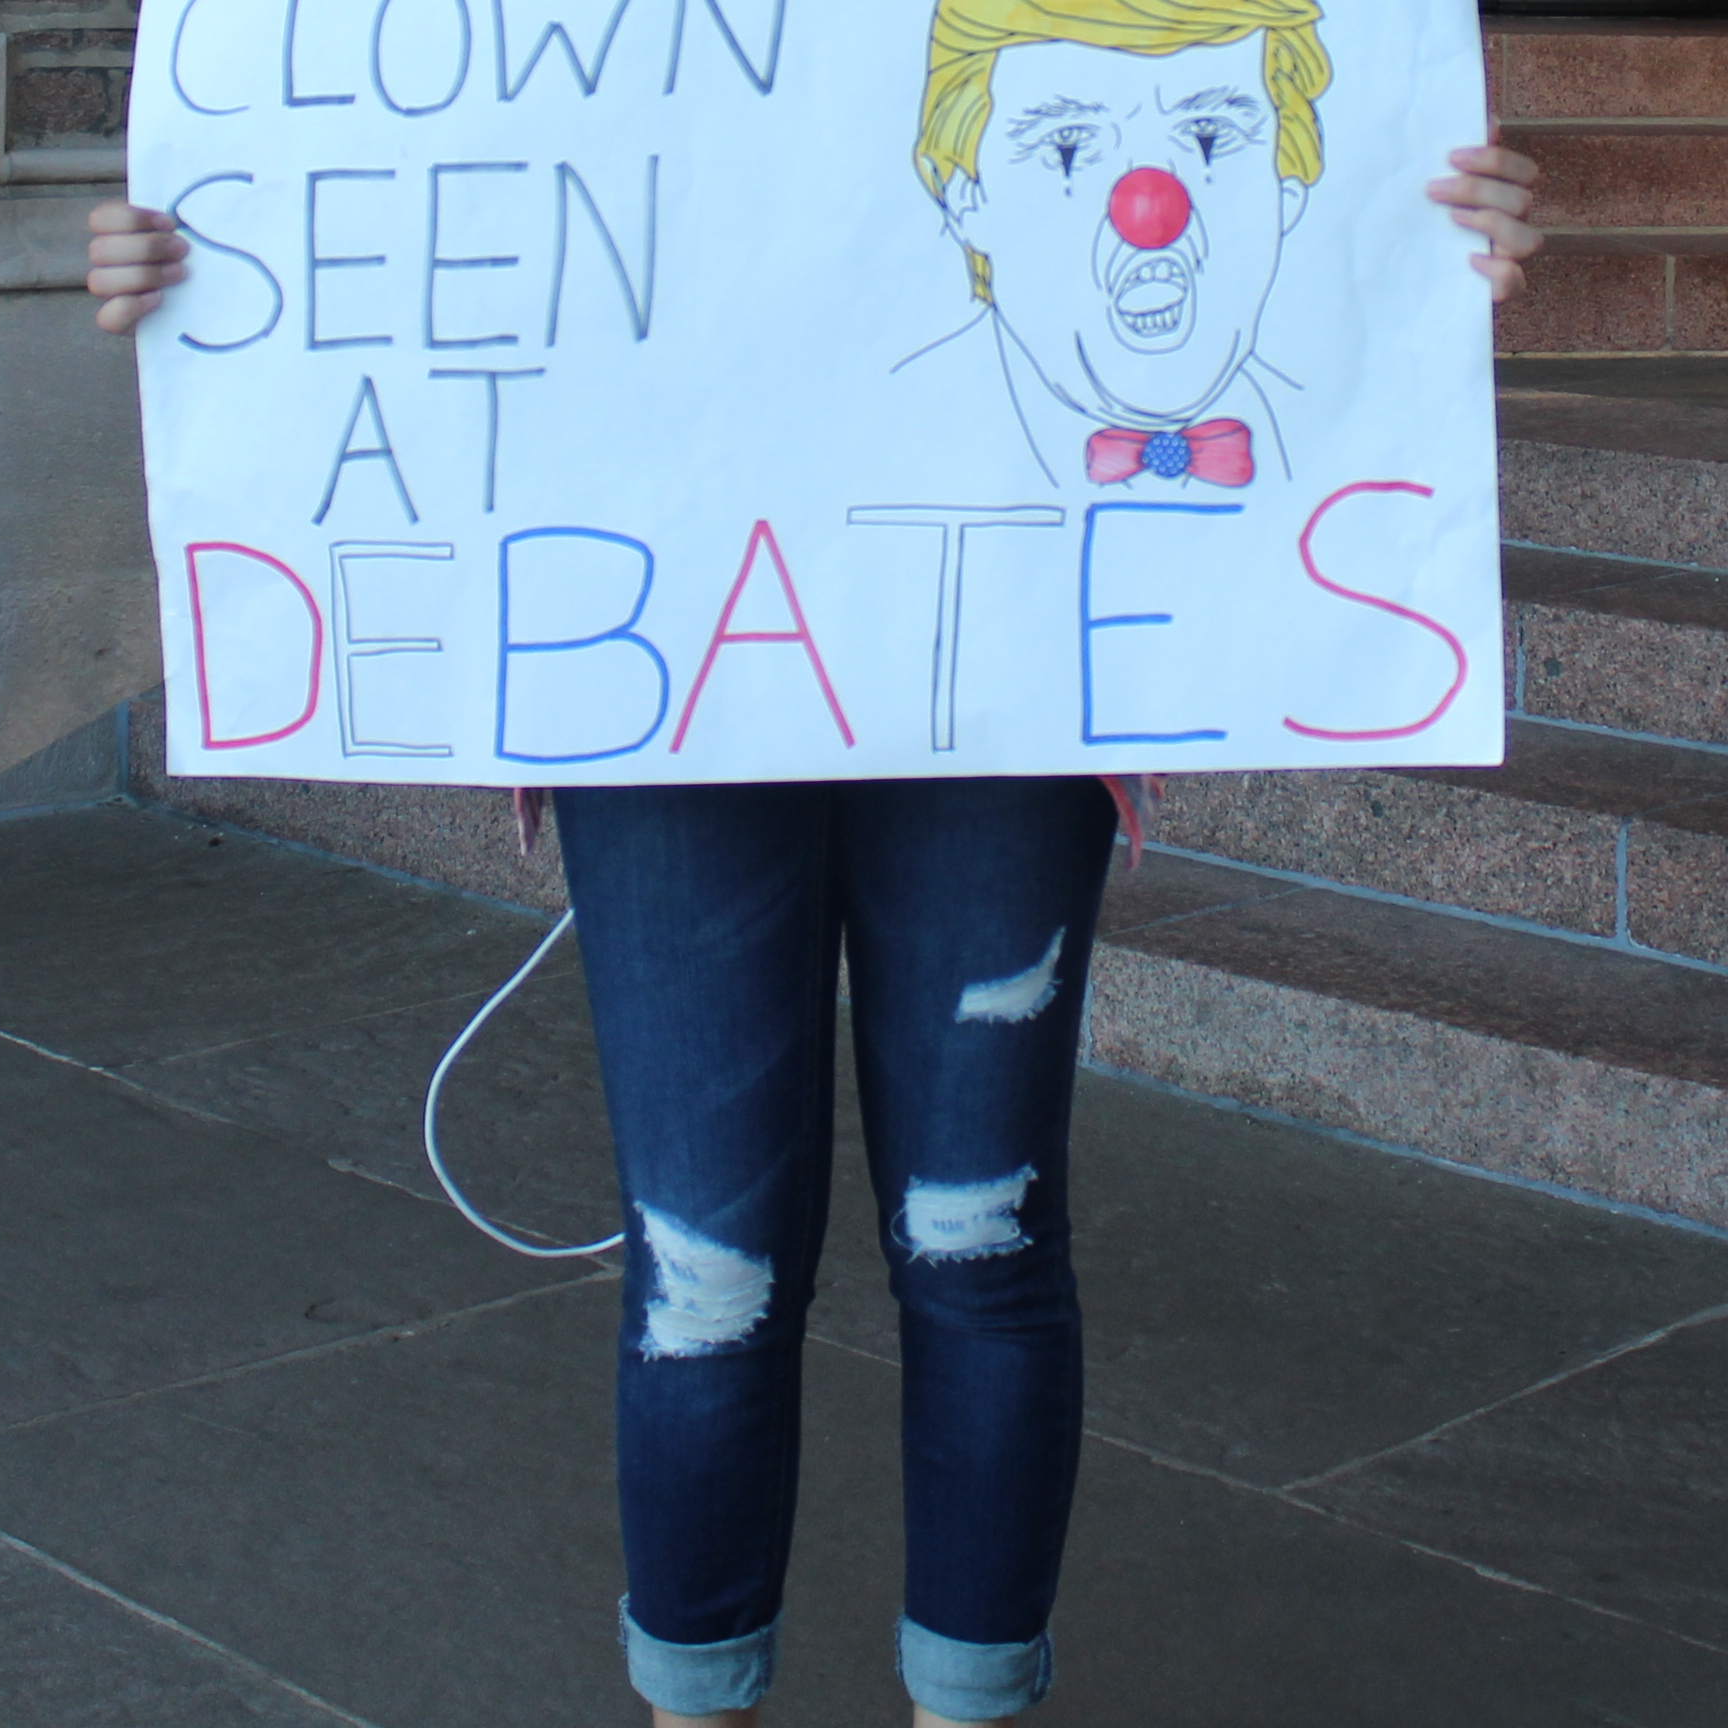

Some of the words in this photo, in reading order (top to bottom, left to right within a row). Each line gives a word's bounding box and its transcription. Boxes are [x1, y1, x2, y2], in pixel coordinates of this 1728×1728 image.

[165, 152, 661, 352] SEEN
[312, 364, 546, 526] AT
[182, 479, 1468, 764] DEBATES
